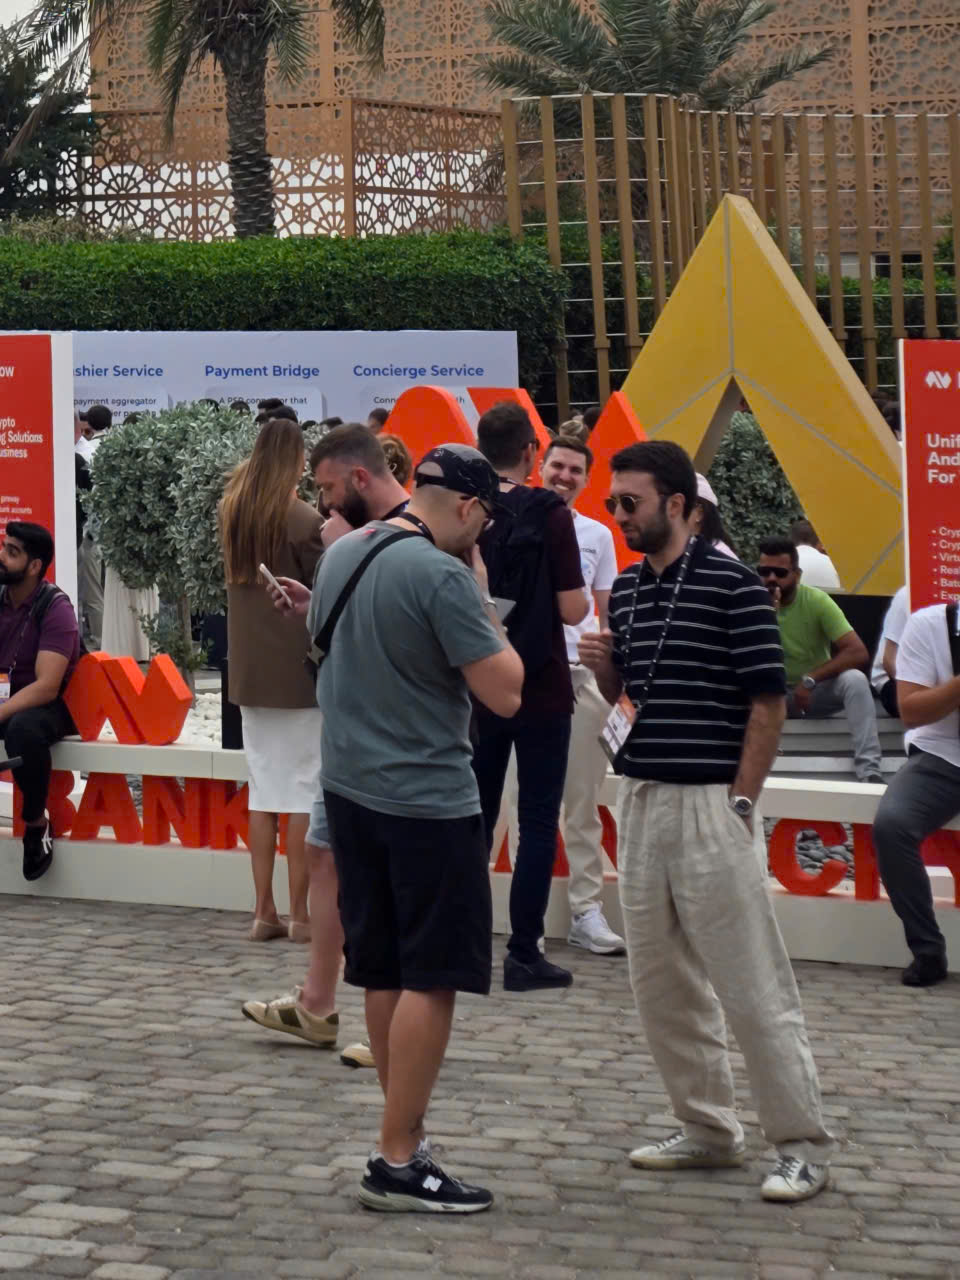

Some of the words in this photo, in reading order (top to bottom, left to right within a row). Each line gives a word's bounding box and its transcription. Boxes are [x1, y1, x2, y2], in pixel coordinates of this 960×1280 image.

[73, 364, 109, 377] shier
[113, 364, 163, 377] Service
[205, 364, 268, 380] Payment
[272, 364, 320, 380] Bridge
[353, 364, 427, 380] Concierge
[431, 364, 485, 377] Service
[112, 398, 156, 407] aggregator
[290, 397, 307, 405] that
[8, 430, 43, 443] Solutions
[928, 468, 956, 484] For
[939, 526, 960, 538] Cryp
[940, 539, 960, 552] Cryp
[940, 552, 960, 562] Virtu
